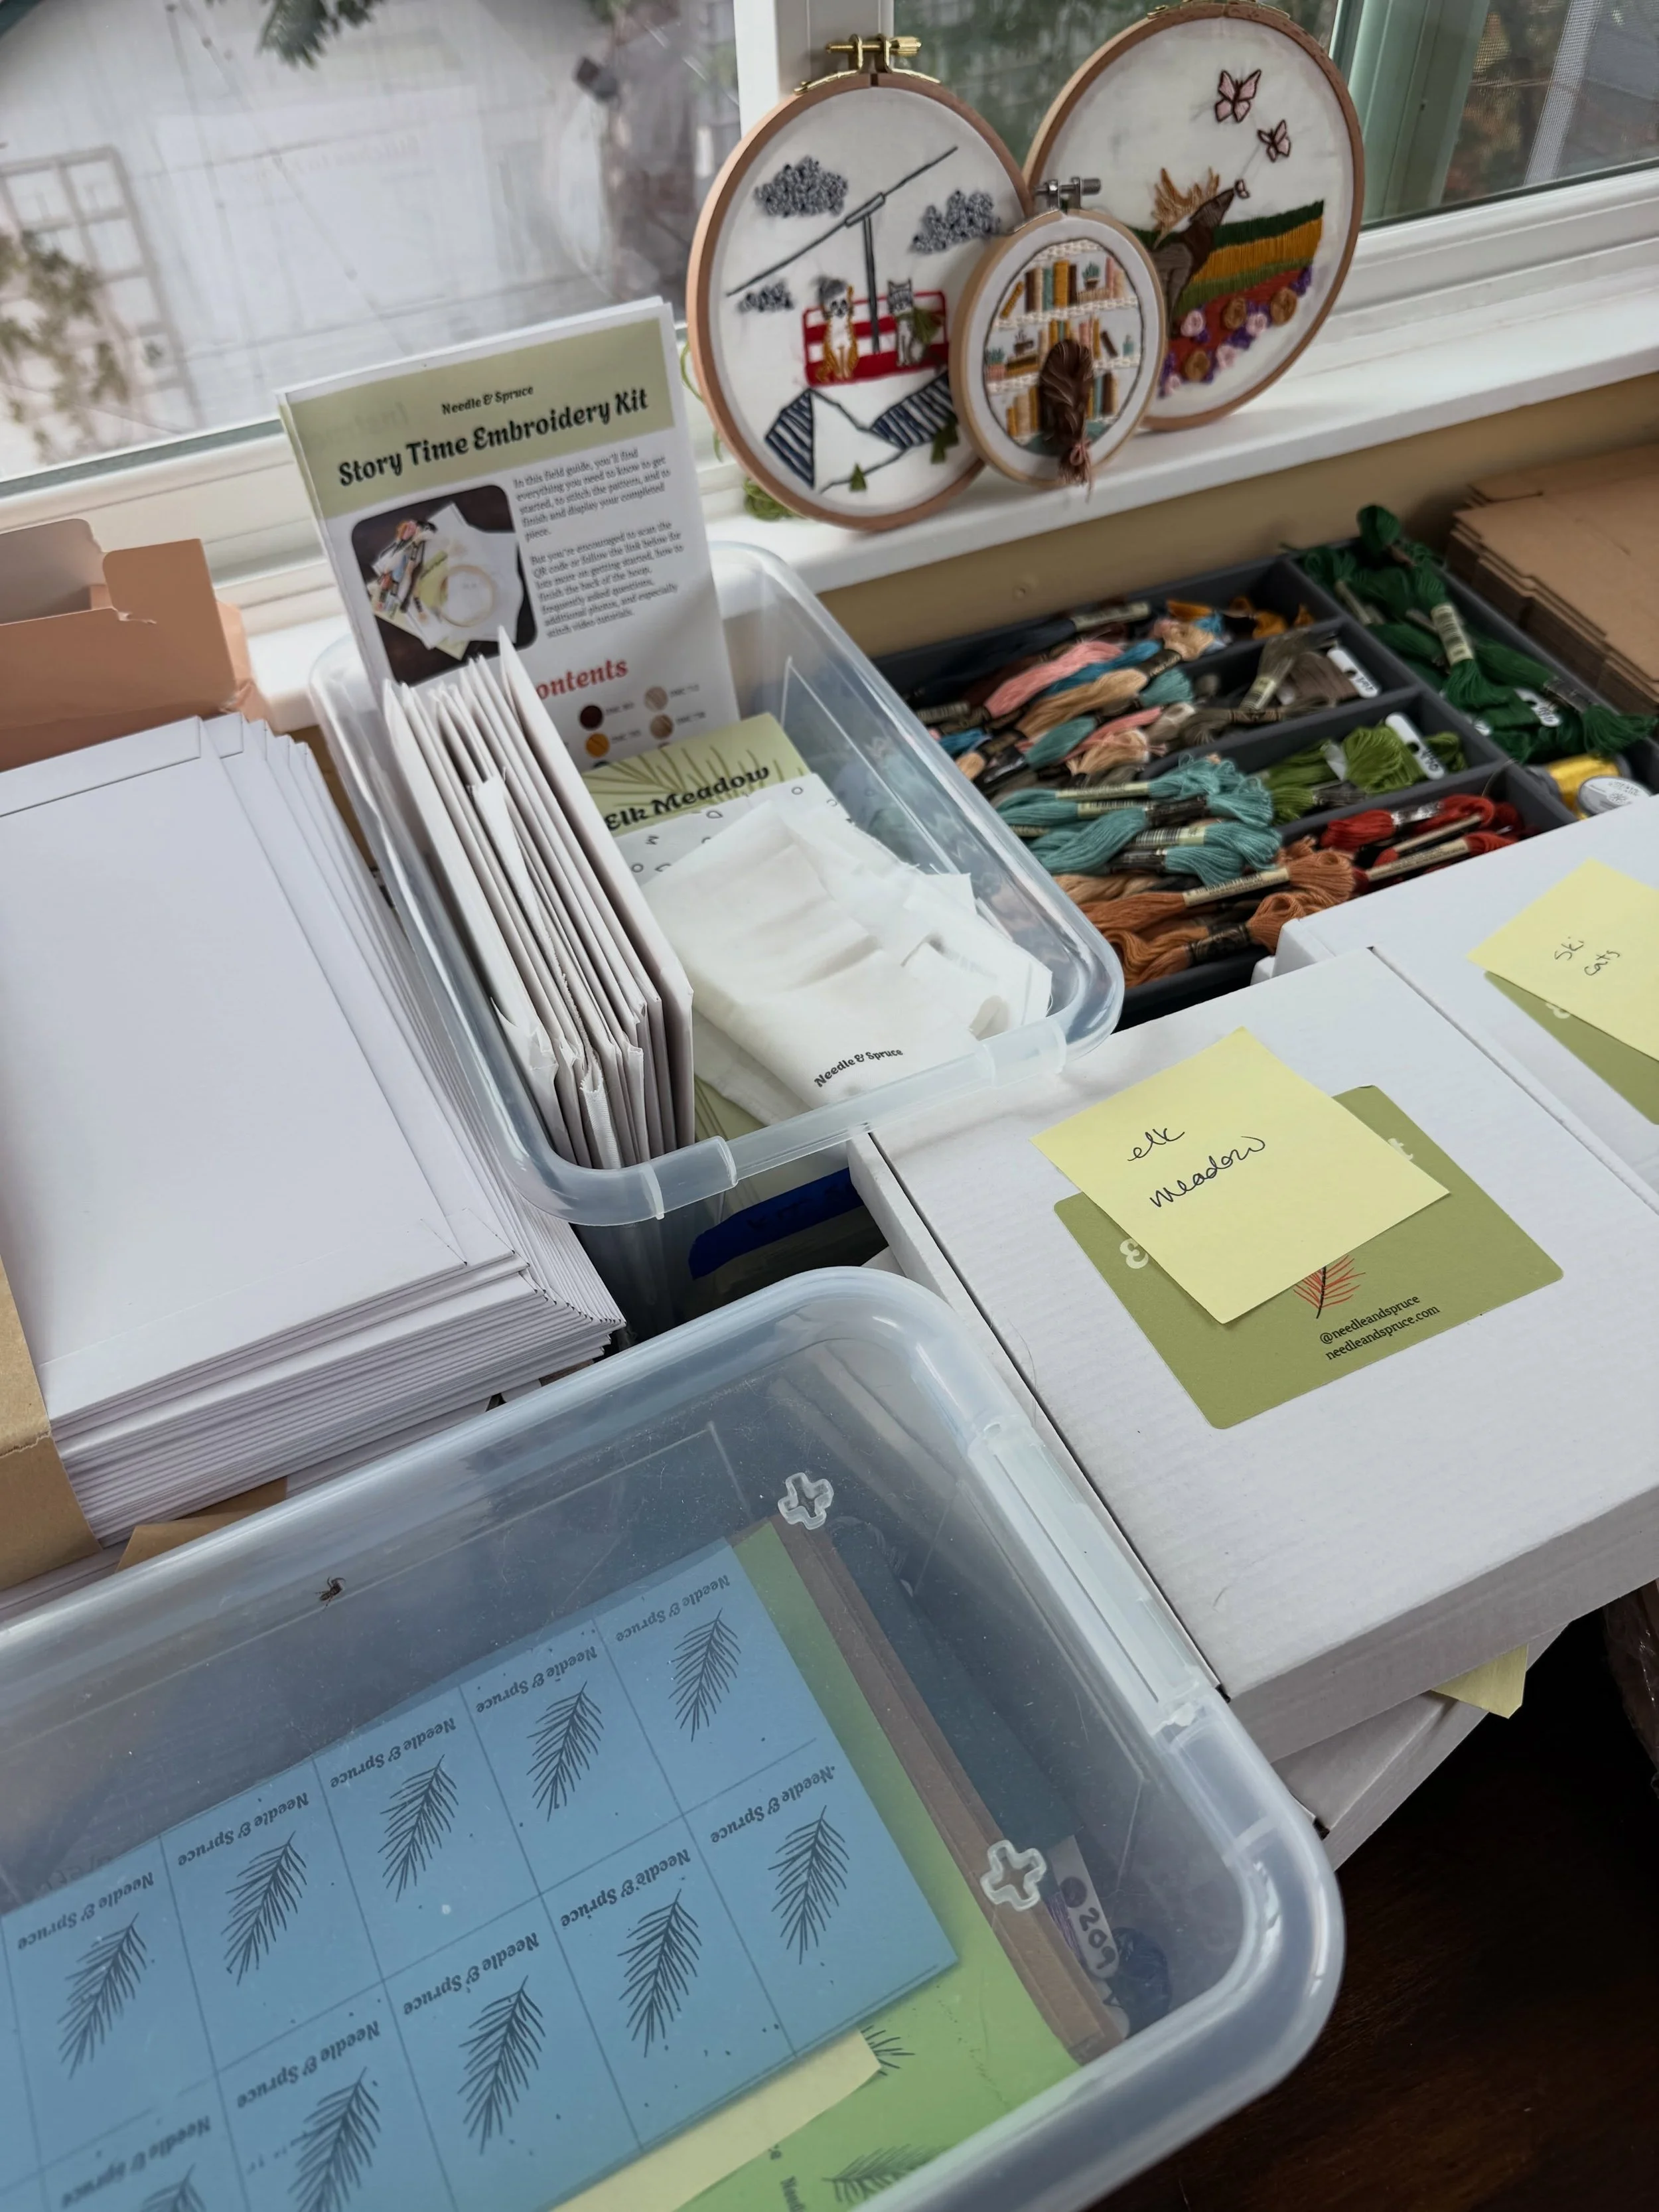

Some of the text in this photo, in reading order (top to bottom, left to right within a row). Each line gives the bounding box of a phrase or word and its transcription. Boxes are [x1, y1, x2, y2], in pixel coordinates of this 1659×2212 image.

[442, 384, 533, 415] Needle & Spruce
[339, 388, 648, 486] Story Time Embroidery Kit
[535, 658, 628, 699] ontents
[605, 767, 770, 831] Elk Meadow
[814, 1049, 903, 1088] Needle & Spruce
[1127, 1128, 1185, 1161] elk
[1149, 1136, 1265, 1208] meadow
[1319, 1296, 1421, 1345] @needleandspruce
[1325, 1306, 1441, 1361] needleandspruce.com
[616, 1575, 730, 1642] Needle & Spruce
[476, 1646, 597, 1712] Needle & Spruce
[330, 1718, 456, 1788] Needle & Spruce
[178, 1793, 309, 1866] Needle & Spruce
[710, 1765, 834, 1843] Needle & Spruce
[80, 1903, 95, 1921] &
[98, 1872, 154, 1908] Needle
[561, 1849, 691, 1927] Needle & Spruce
[18, 1912, 77, 1950] Spruce
[1079, 1907, 1116, 1970] 209
[403, 1932, 540, 2015] Needle & Spruce
[237, 2020, 380, 2108] Needle & Spruce
